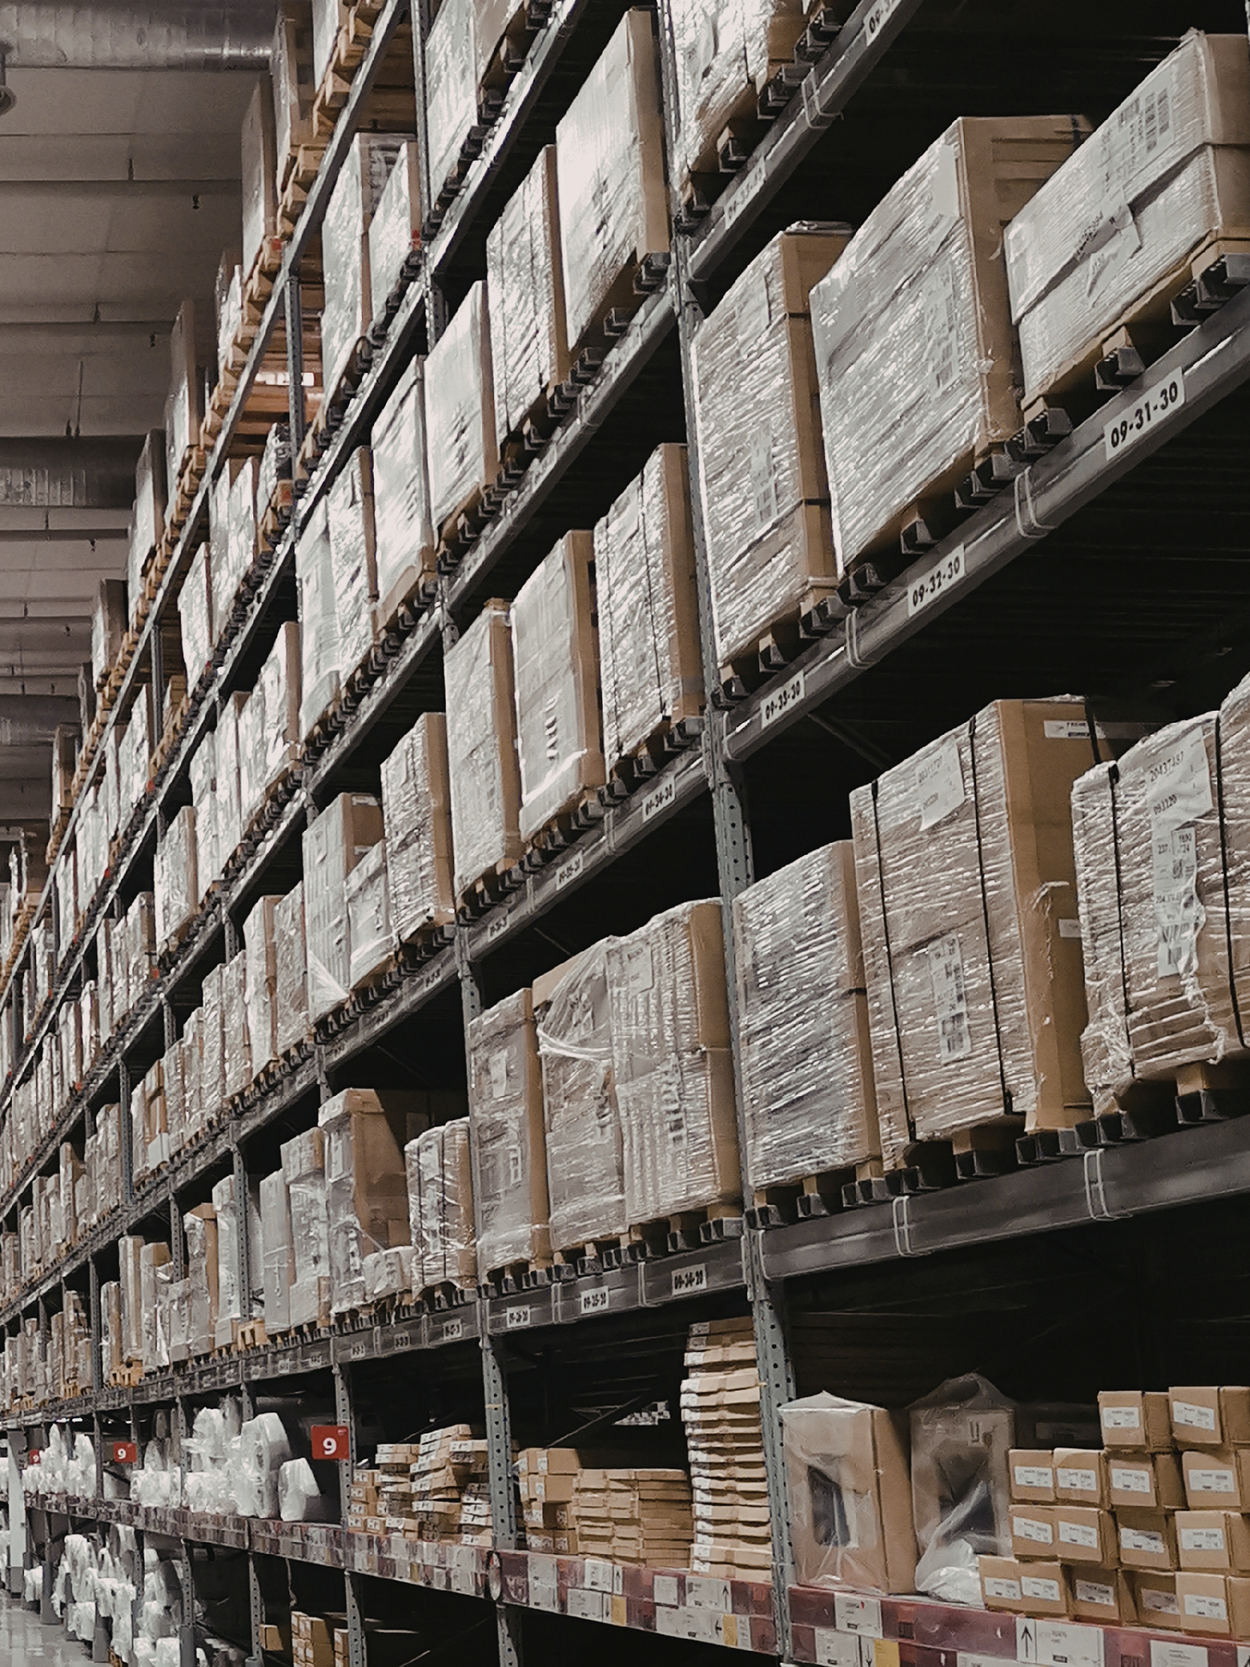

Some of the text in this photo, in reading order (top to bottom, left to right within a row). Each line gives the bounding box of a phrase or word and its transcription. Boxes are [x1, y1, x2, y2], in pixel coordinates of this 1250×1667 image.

[1110, 380, 1179, 449] 09-31-30
[912, 555, 961, 608] 09-32-30
[117, 1448, 127, 1460] 9
[322, 1437, 338, 1456] 9
[32, 1454, 40, 1463] 9
